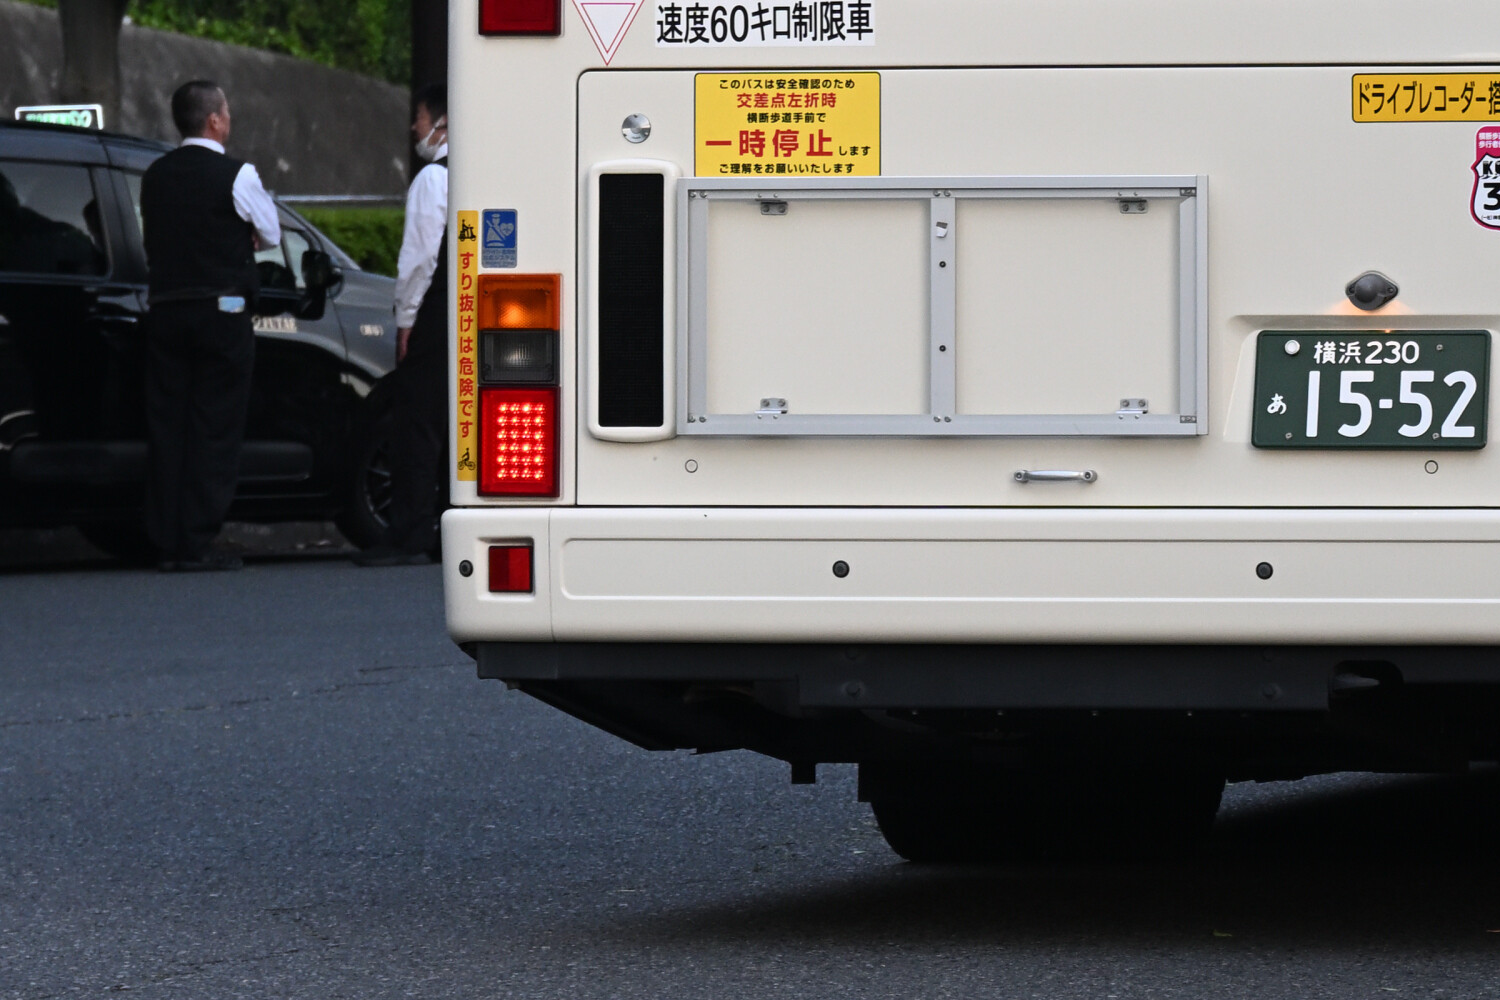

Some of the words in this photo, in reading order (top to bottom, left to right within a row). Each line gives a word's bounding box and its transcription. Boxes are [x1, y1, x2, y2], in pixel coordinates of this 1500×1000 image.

[656, 0, 874, 44] 速度60キロ制限車
[718, 79, 856, 90] このバスは安全確認のため
[736, 93, 837, 109] 交差点左折時
[746, 112, 827, 124] 横断歩道手前で
[705, 129, 833, 157] 一時停止
[838, 146, 871, 157] します
[718, 163, 856, 174] ご理解をお願いいたします
[459, 251, 475, 438] すり抜けは危険です
[1266, 393, 1287, 415] あ
[1305, 370, 1478, 438] 15-52
